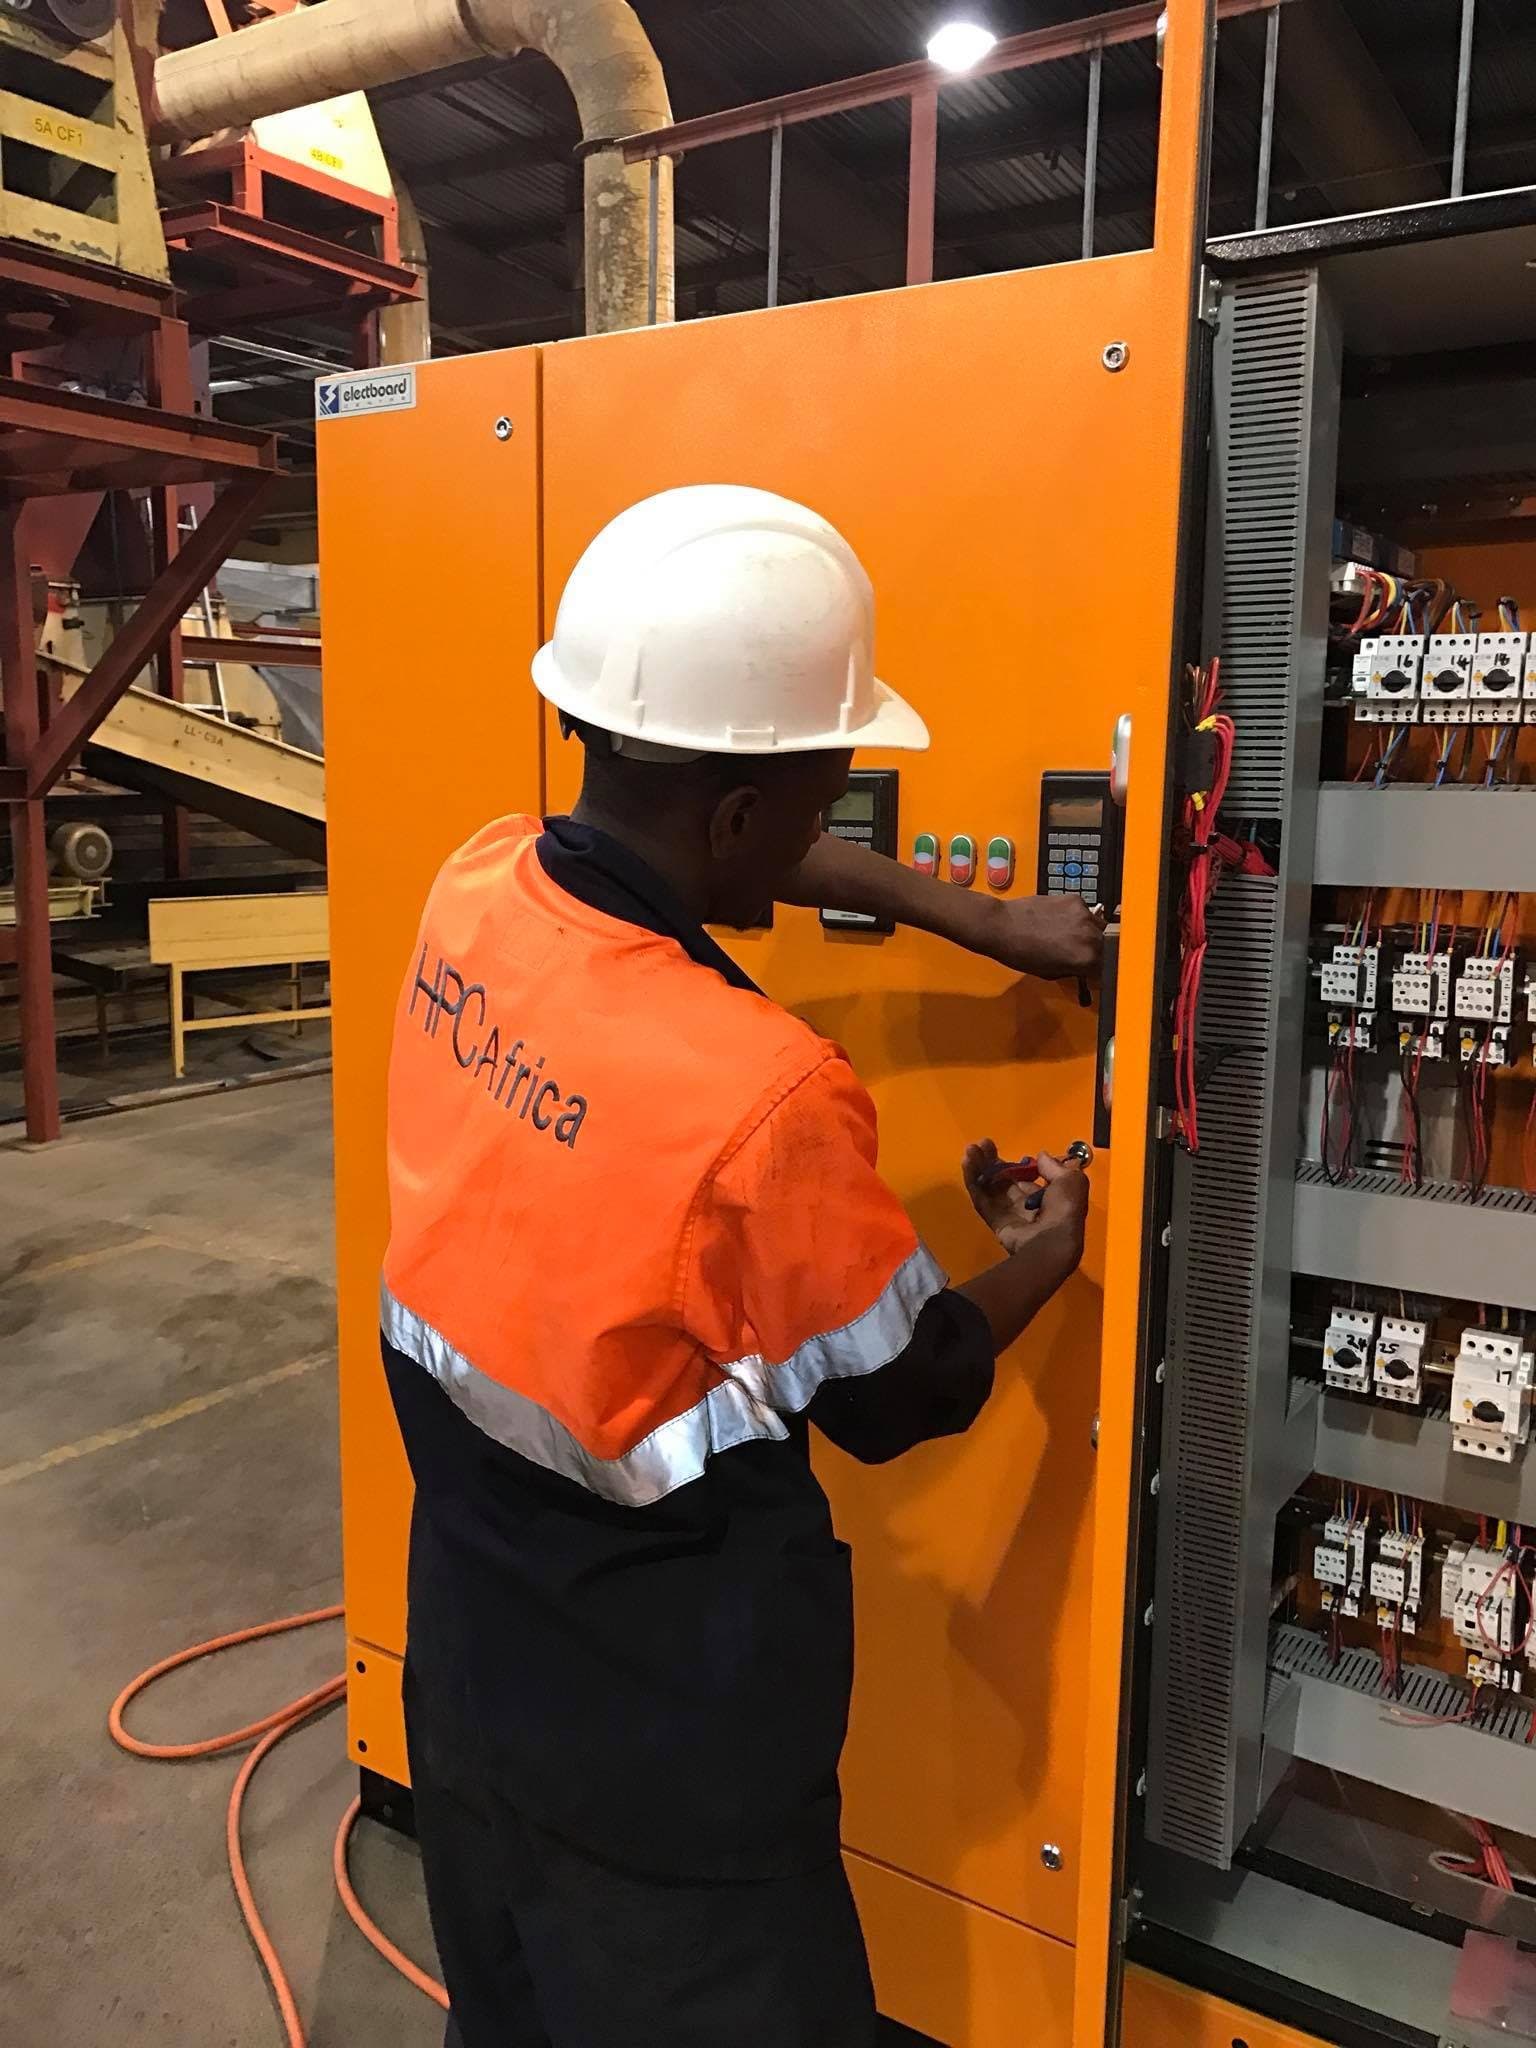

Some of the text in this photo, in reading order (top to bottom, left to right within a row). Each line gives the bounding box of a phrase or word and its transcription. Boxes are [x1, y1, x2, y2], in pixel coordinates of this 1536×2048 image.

[34, 117, 83, 147] 5A CF1
[343, 378, 407, 402] electboard
[1397, 654, 1414, 668] 16
[1450, 654, 1470, 671] 14
[1346, 1334, 1368, 1353] 24
[1379, 1342, 1400, 1354] 25
[1496, 1369, 1512, 1386] 17
